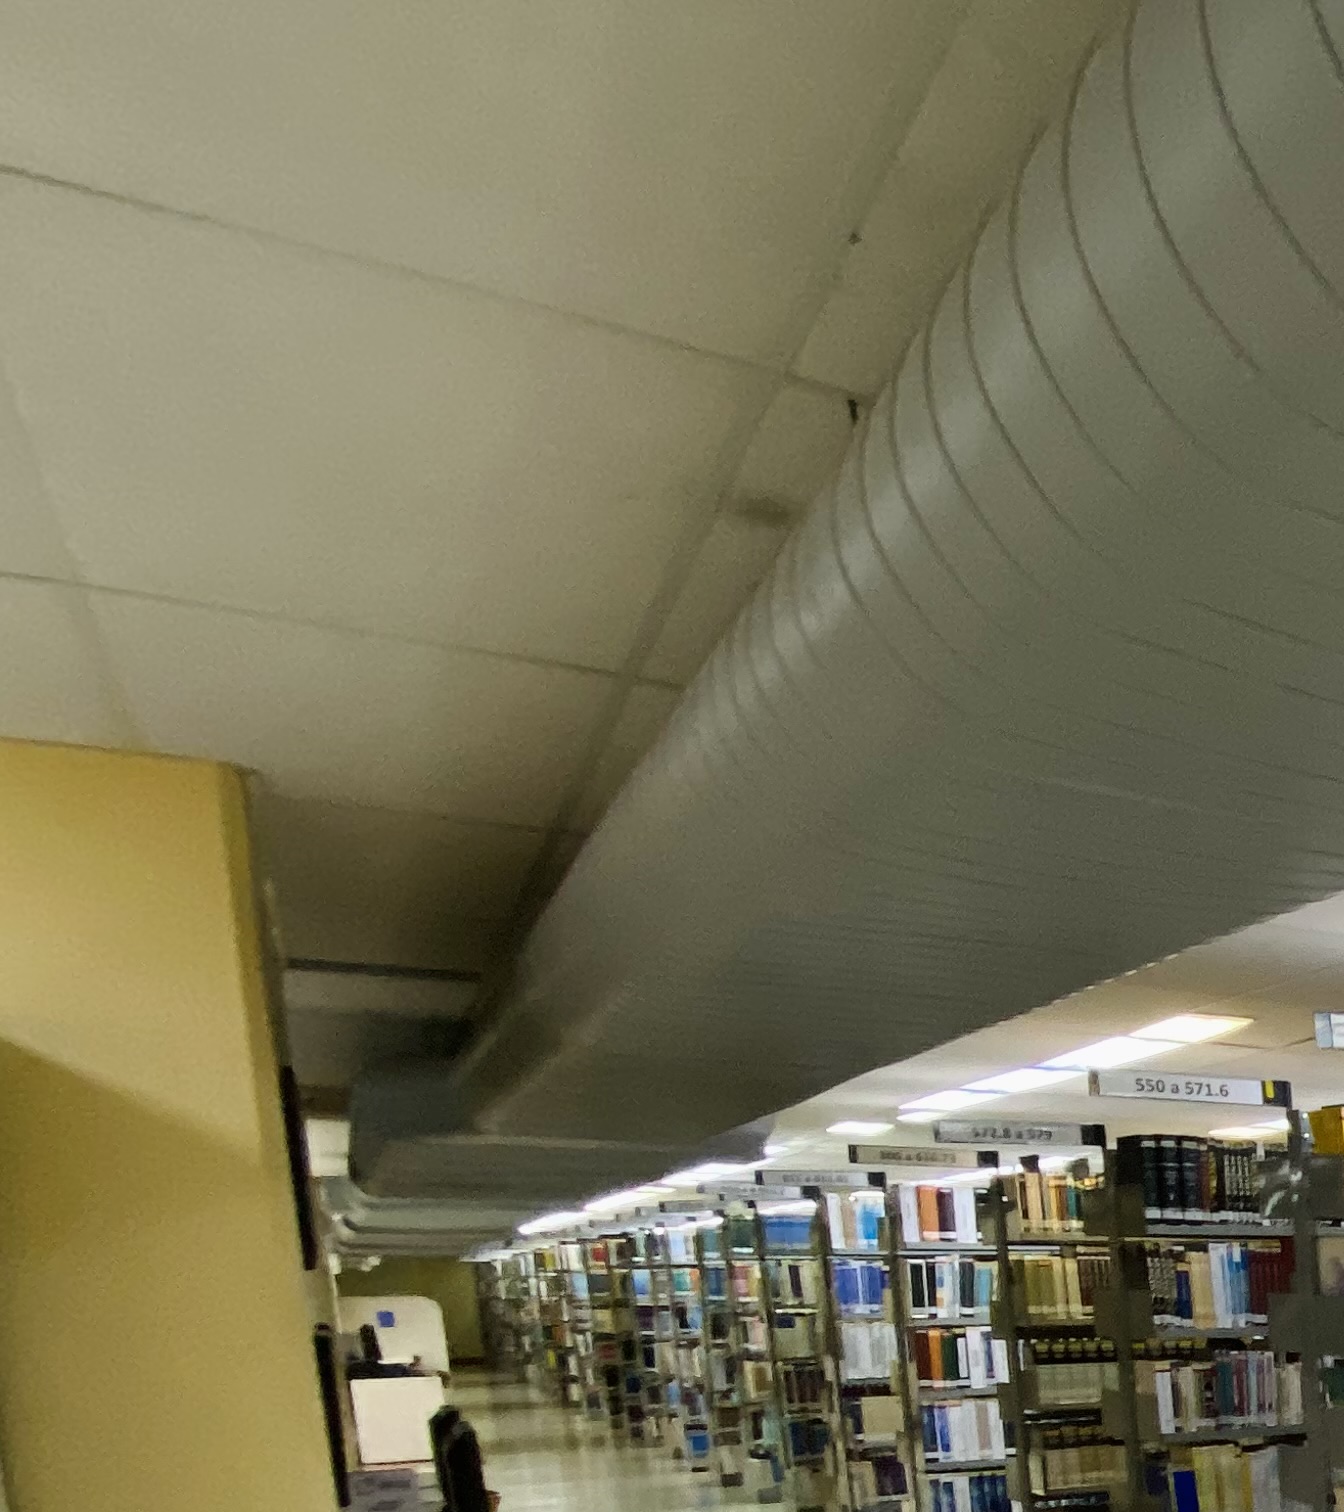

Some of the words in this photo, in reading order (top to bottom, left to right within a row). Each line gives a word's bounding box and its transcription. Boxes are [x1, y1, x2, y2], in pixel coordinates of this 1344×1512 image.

[1135, 1078, 1165, 1093] 550
[1171, 1084, 1180, 1094] a
[1184, 1081, 1230, 1097] 571.6
